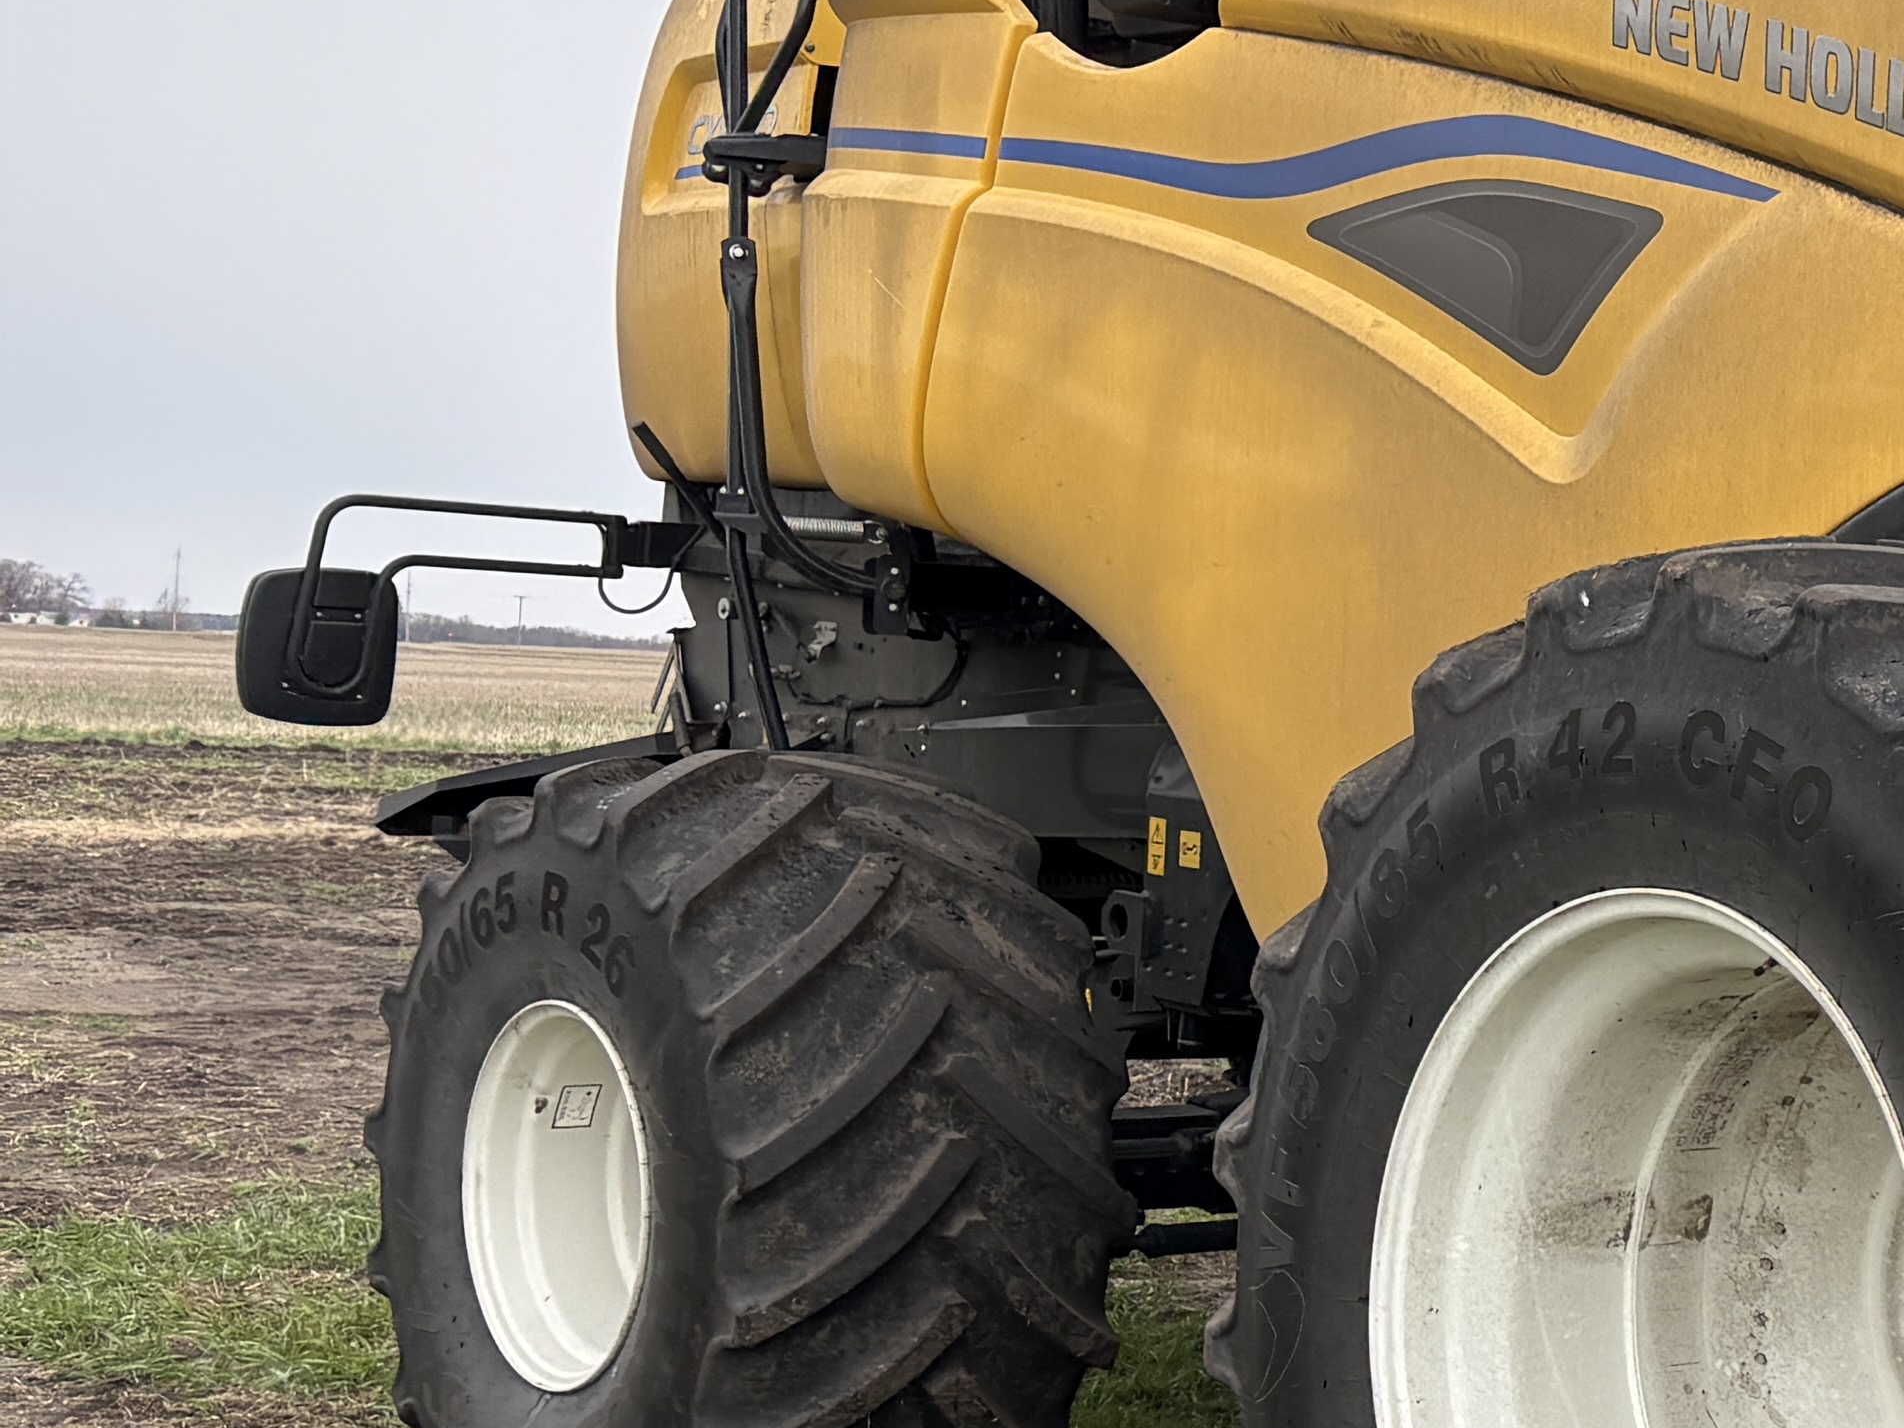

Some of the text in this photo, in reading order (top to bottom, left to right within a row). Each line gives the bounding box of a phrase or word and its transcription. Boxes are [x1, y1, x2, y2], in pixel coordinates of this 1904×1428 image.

[1479, 737, 1521, 815] R
[1549, 700, 1637, 780] 42
[1678, 709, 1833, 843] CFO
[541, 870, 568, 939] R
[580, 903, 636, 999] 26
